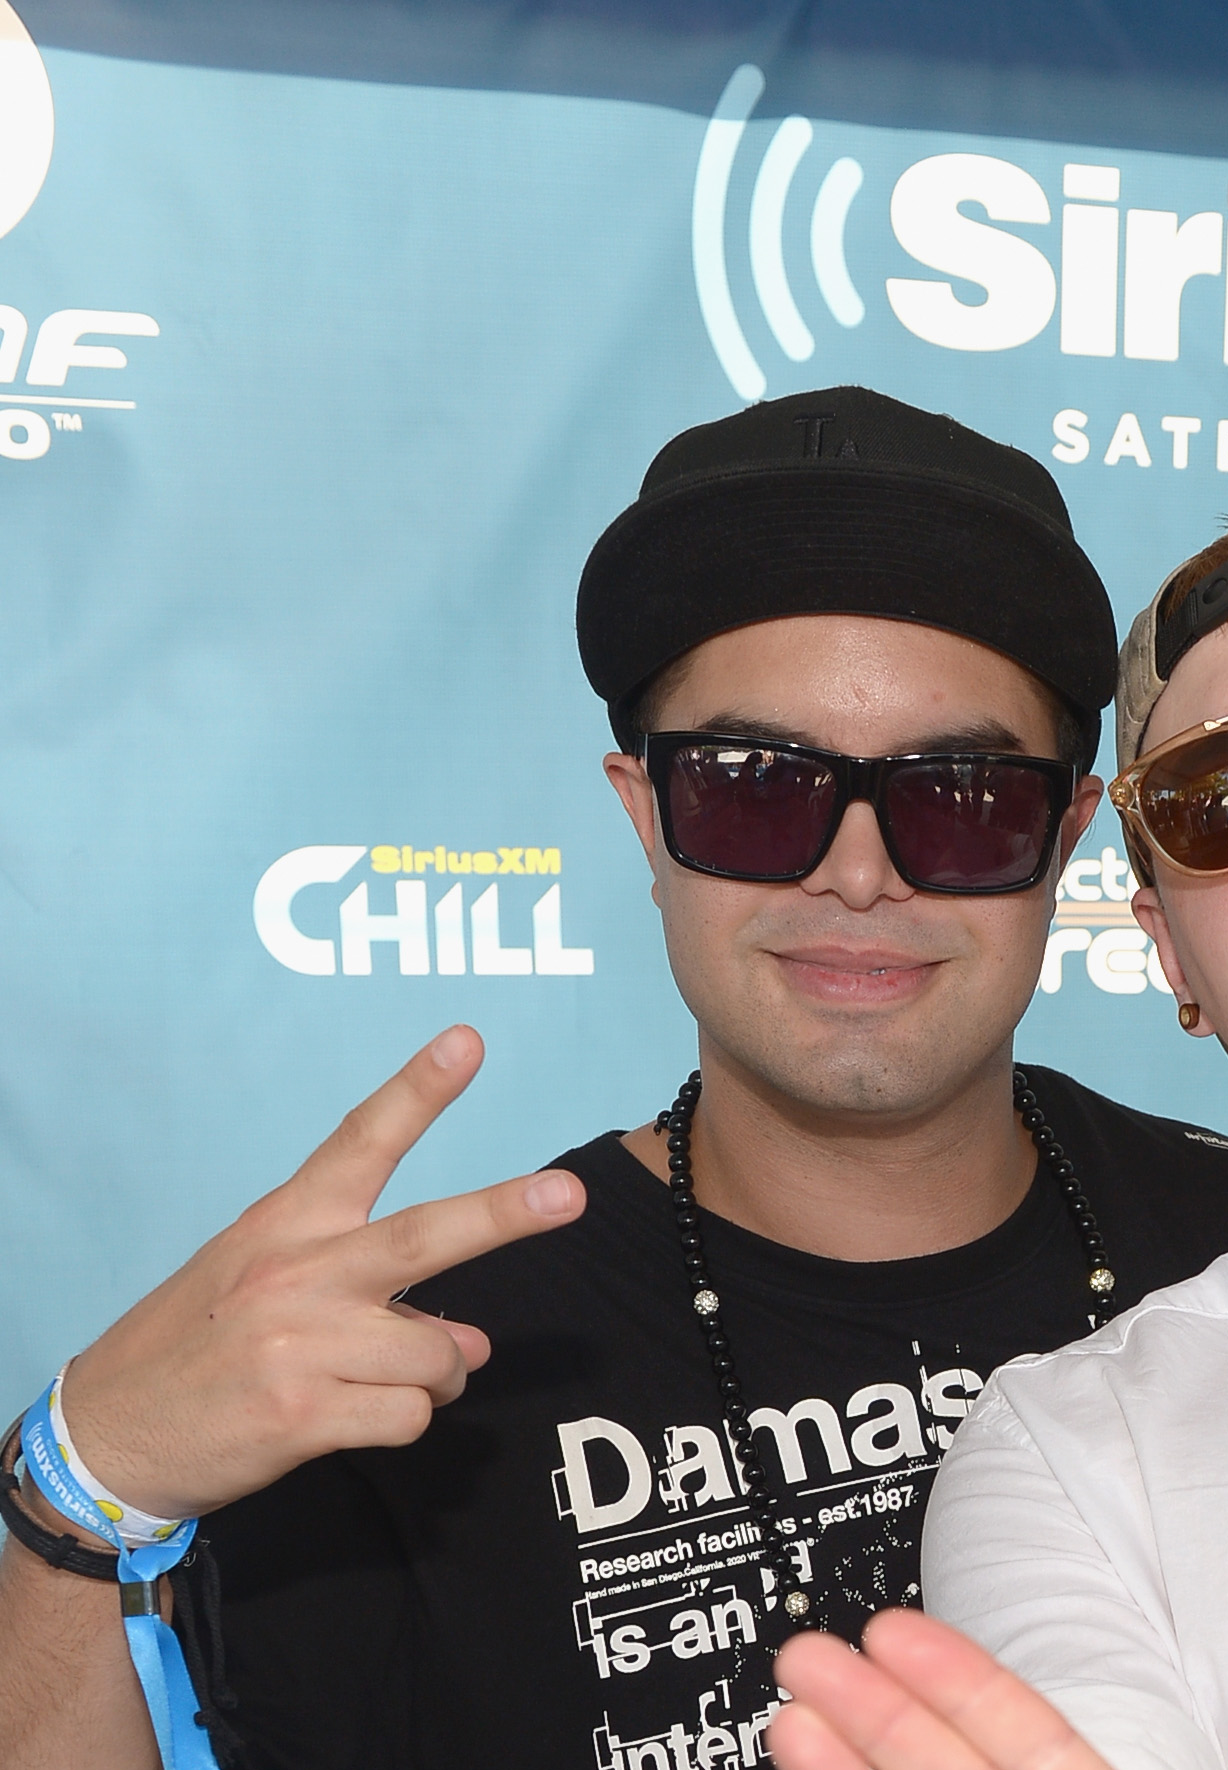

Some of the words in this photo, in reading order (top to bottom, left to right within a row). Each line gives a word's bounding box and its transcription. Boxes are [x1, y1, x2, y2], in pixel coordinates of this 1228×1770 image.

[370, 845, 562, 875] SiriusXM
[253, 845, 595, 976] CHILL
[580, 1521, 694, 1584] Research
[592, 1617, 652, 1679] is
[670, 1599, 758, 1659] an
